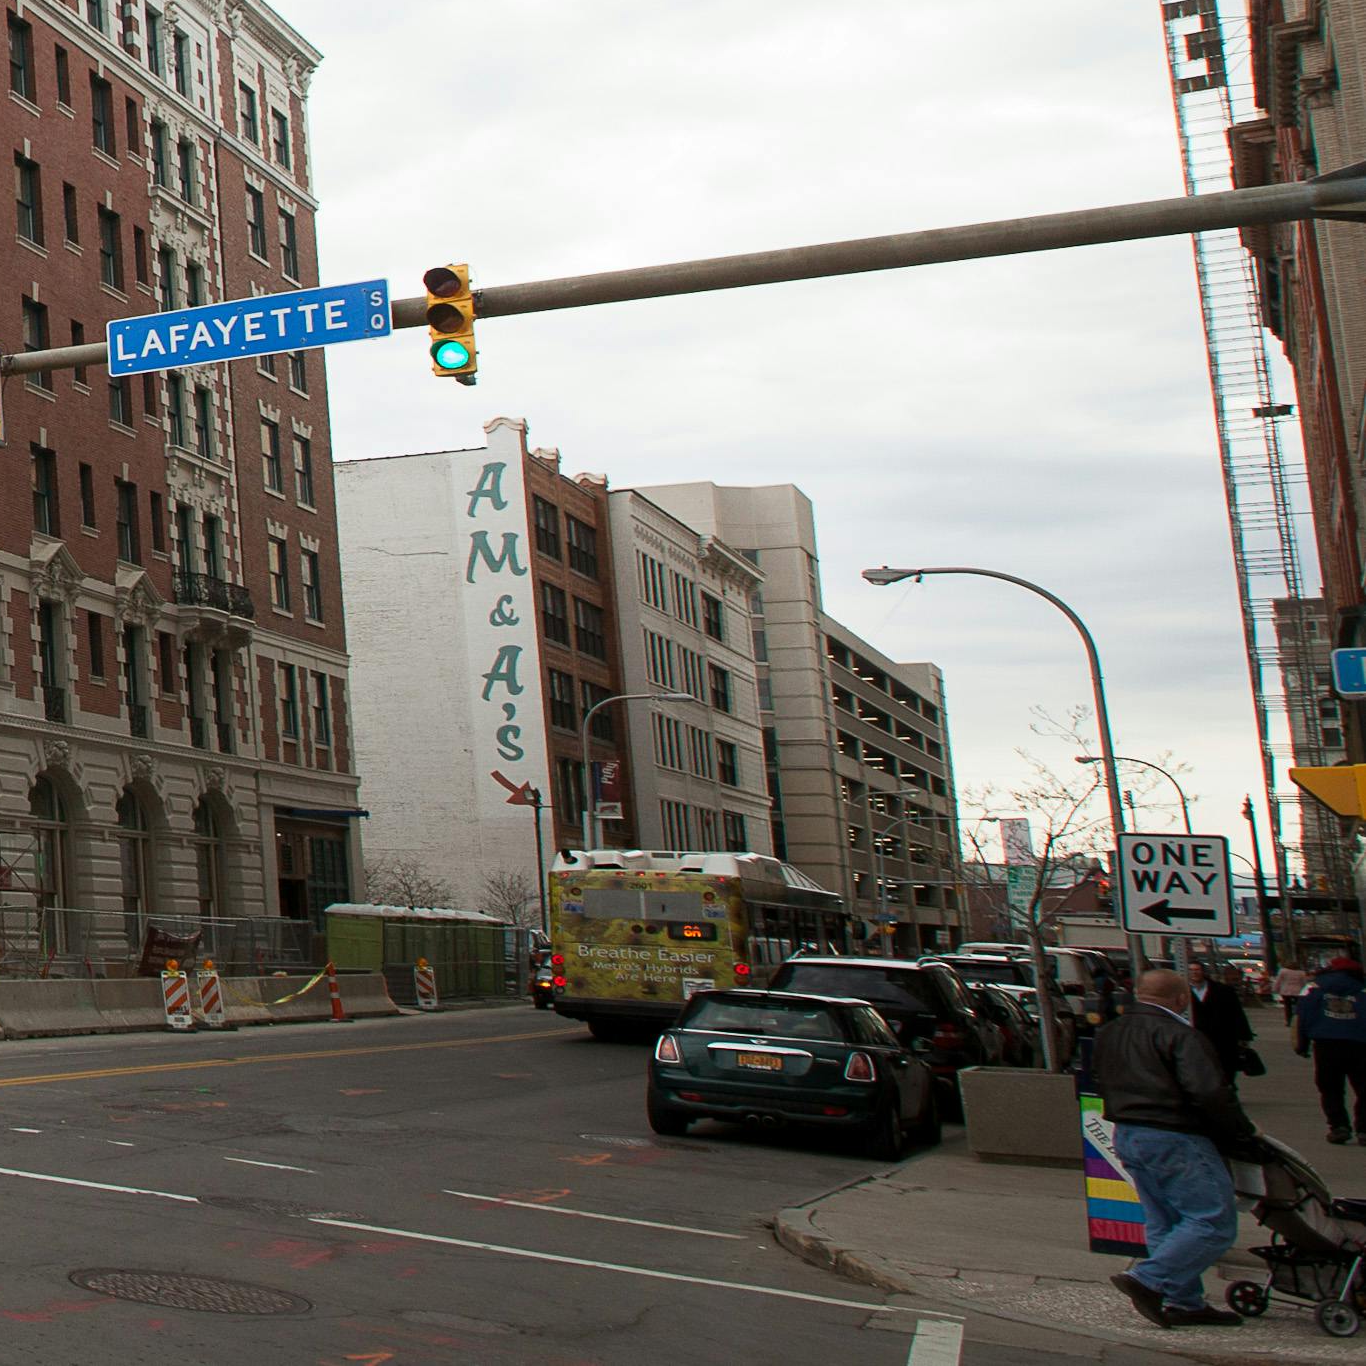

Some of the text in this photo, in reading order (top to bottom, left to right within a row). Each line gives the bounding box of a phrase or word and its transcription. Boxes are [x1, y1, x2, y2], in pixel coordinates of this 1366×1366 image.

[116, 290, 384, 362] LAFAYETTE SQ
[1131, 841, 1216, 868] ONE
[1131, 869, 1220, 896] WAY
[577, 944, 716, 964] Breathe Easier
[592, 961, 700, 976] Metro's Hybrids
[615, 973, 677, 984] Are Here
[1085, 1118, 1111, 1145] THE
